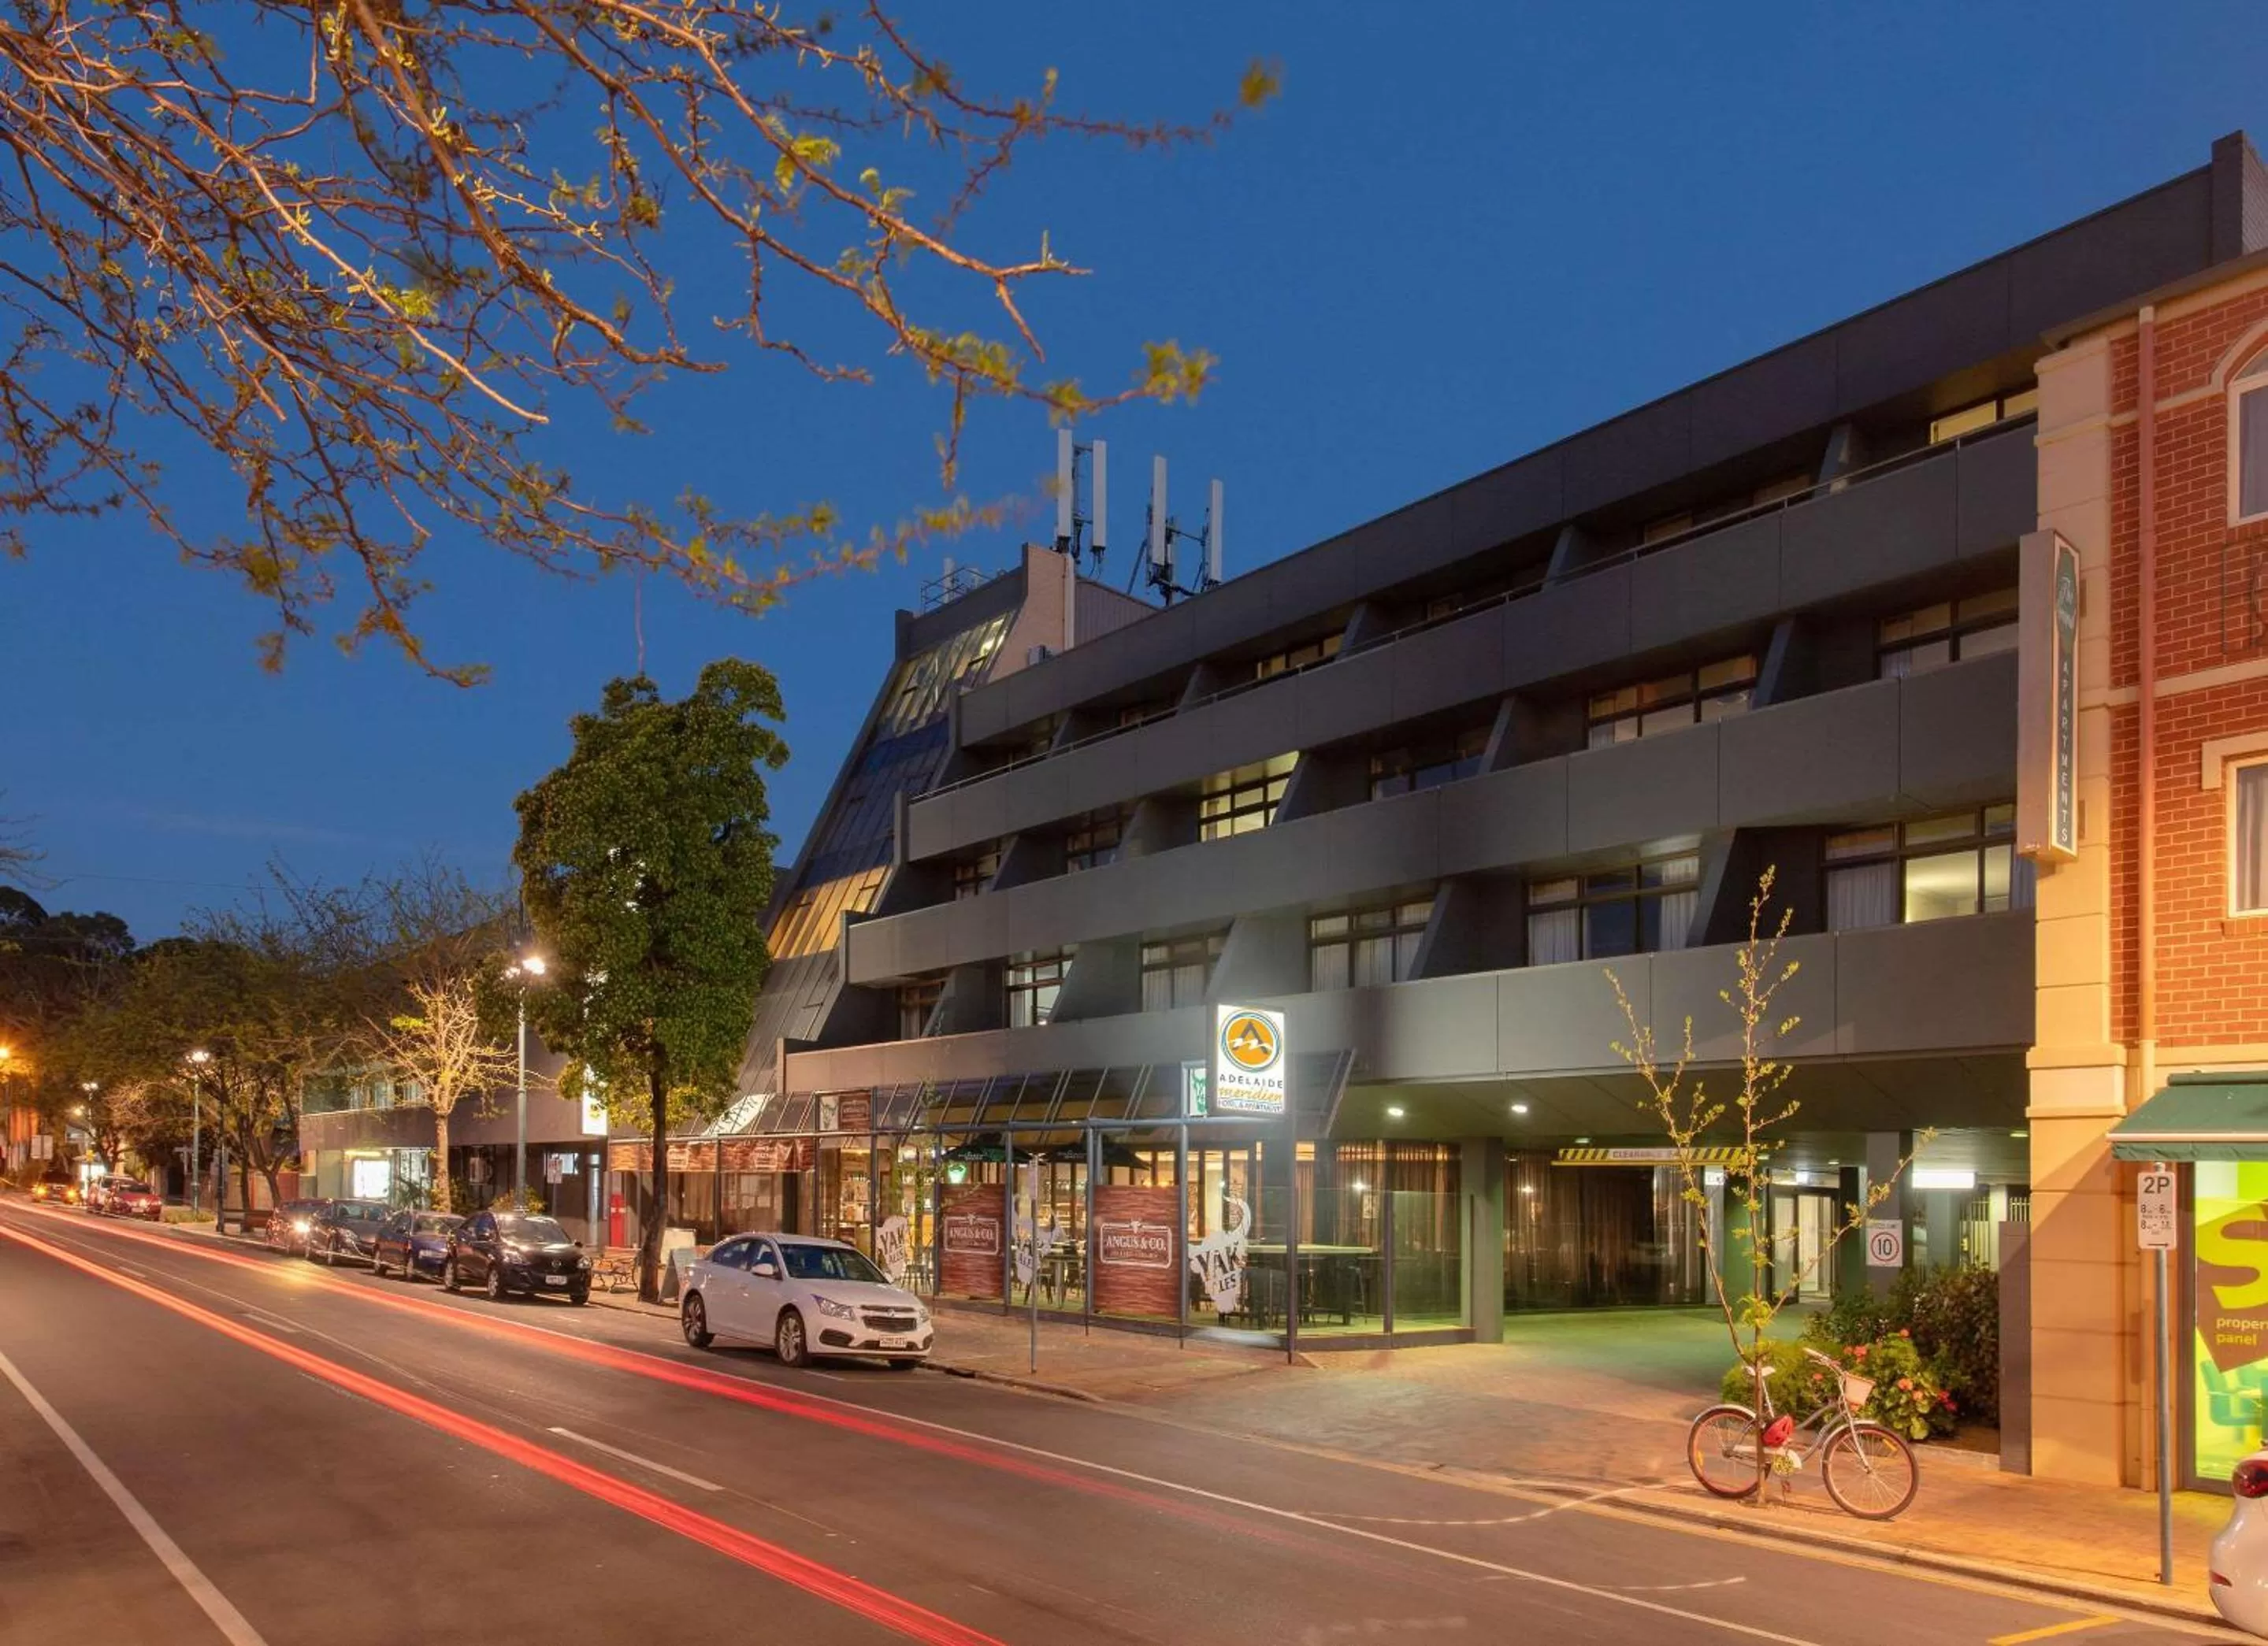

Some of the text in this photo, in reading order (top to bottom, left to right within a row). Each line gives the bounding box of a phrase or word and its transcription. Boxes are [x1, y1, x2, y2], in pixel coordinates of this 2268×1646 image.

[2061, 660, 2069, 842] APARTMENTS
[1219, 1073, 1283, 1088] ADELAIDE
[2144, 1177, 2170, 1194] 2P
[880, 1224, 905, 1255] YAK
[949, 1226, 974, 1239] ANGUS
[1106, 1234, 1166, 1251] ANGUS & CO.
[1877, 1239, 1892, 1255] 10
[1195, 1241, 1240, 1279] YAK
[2216, 1333, 2257, 1345] panel
